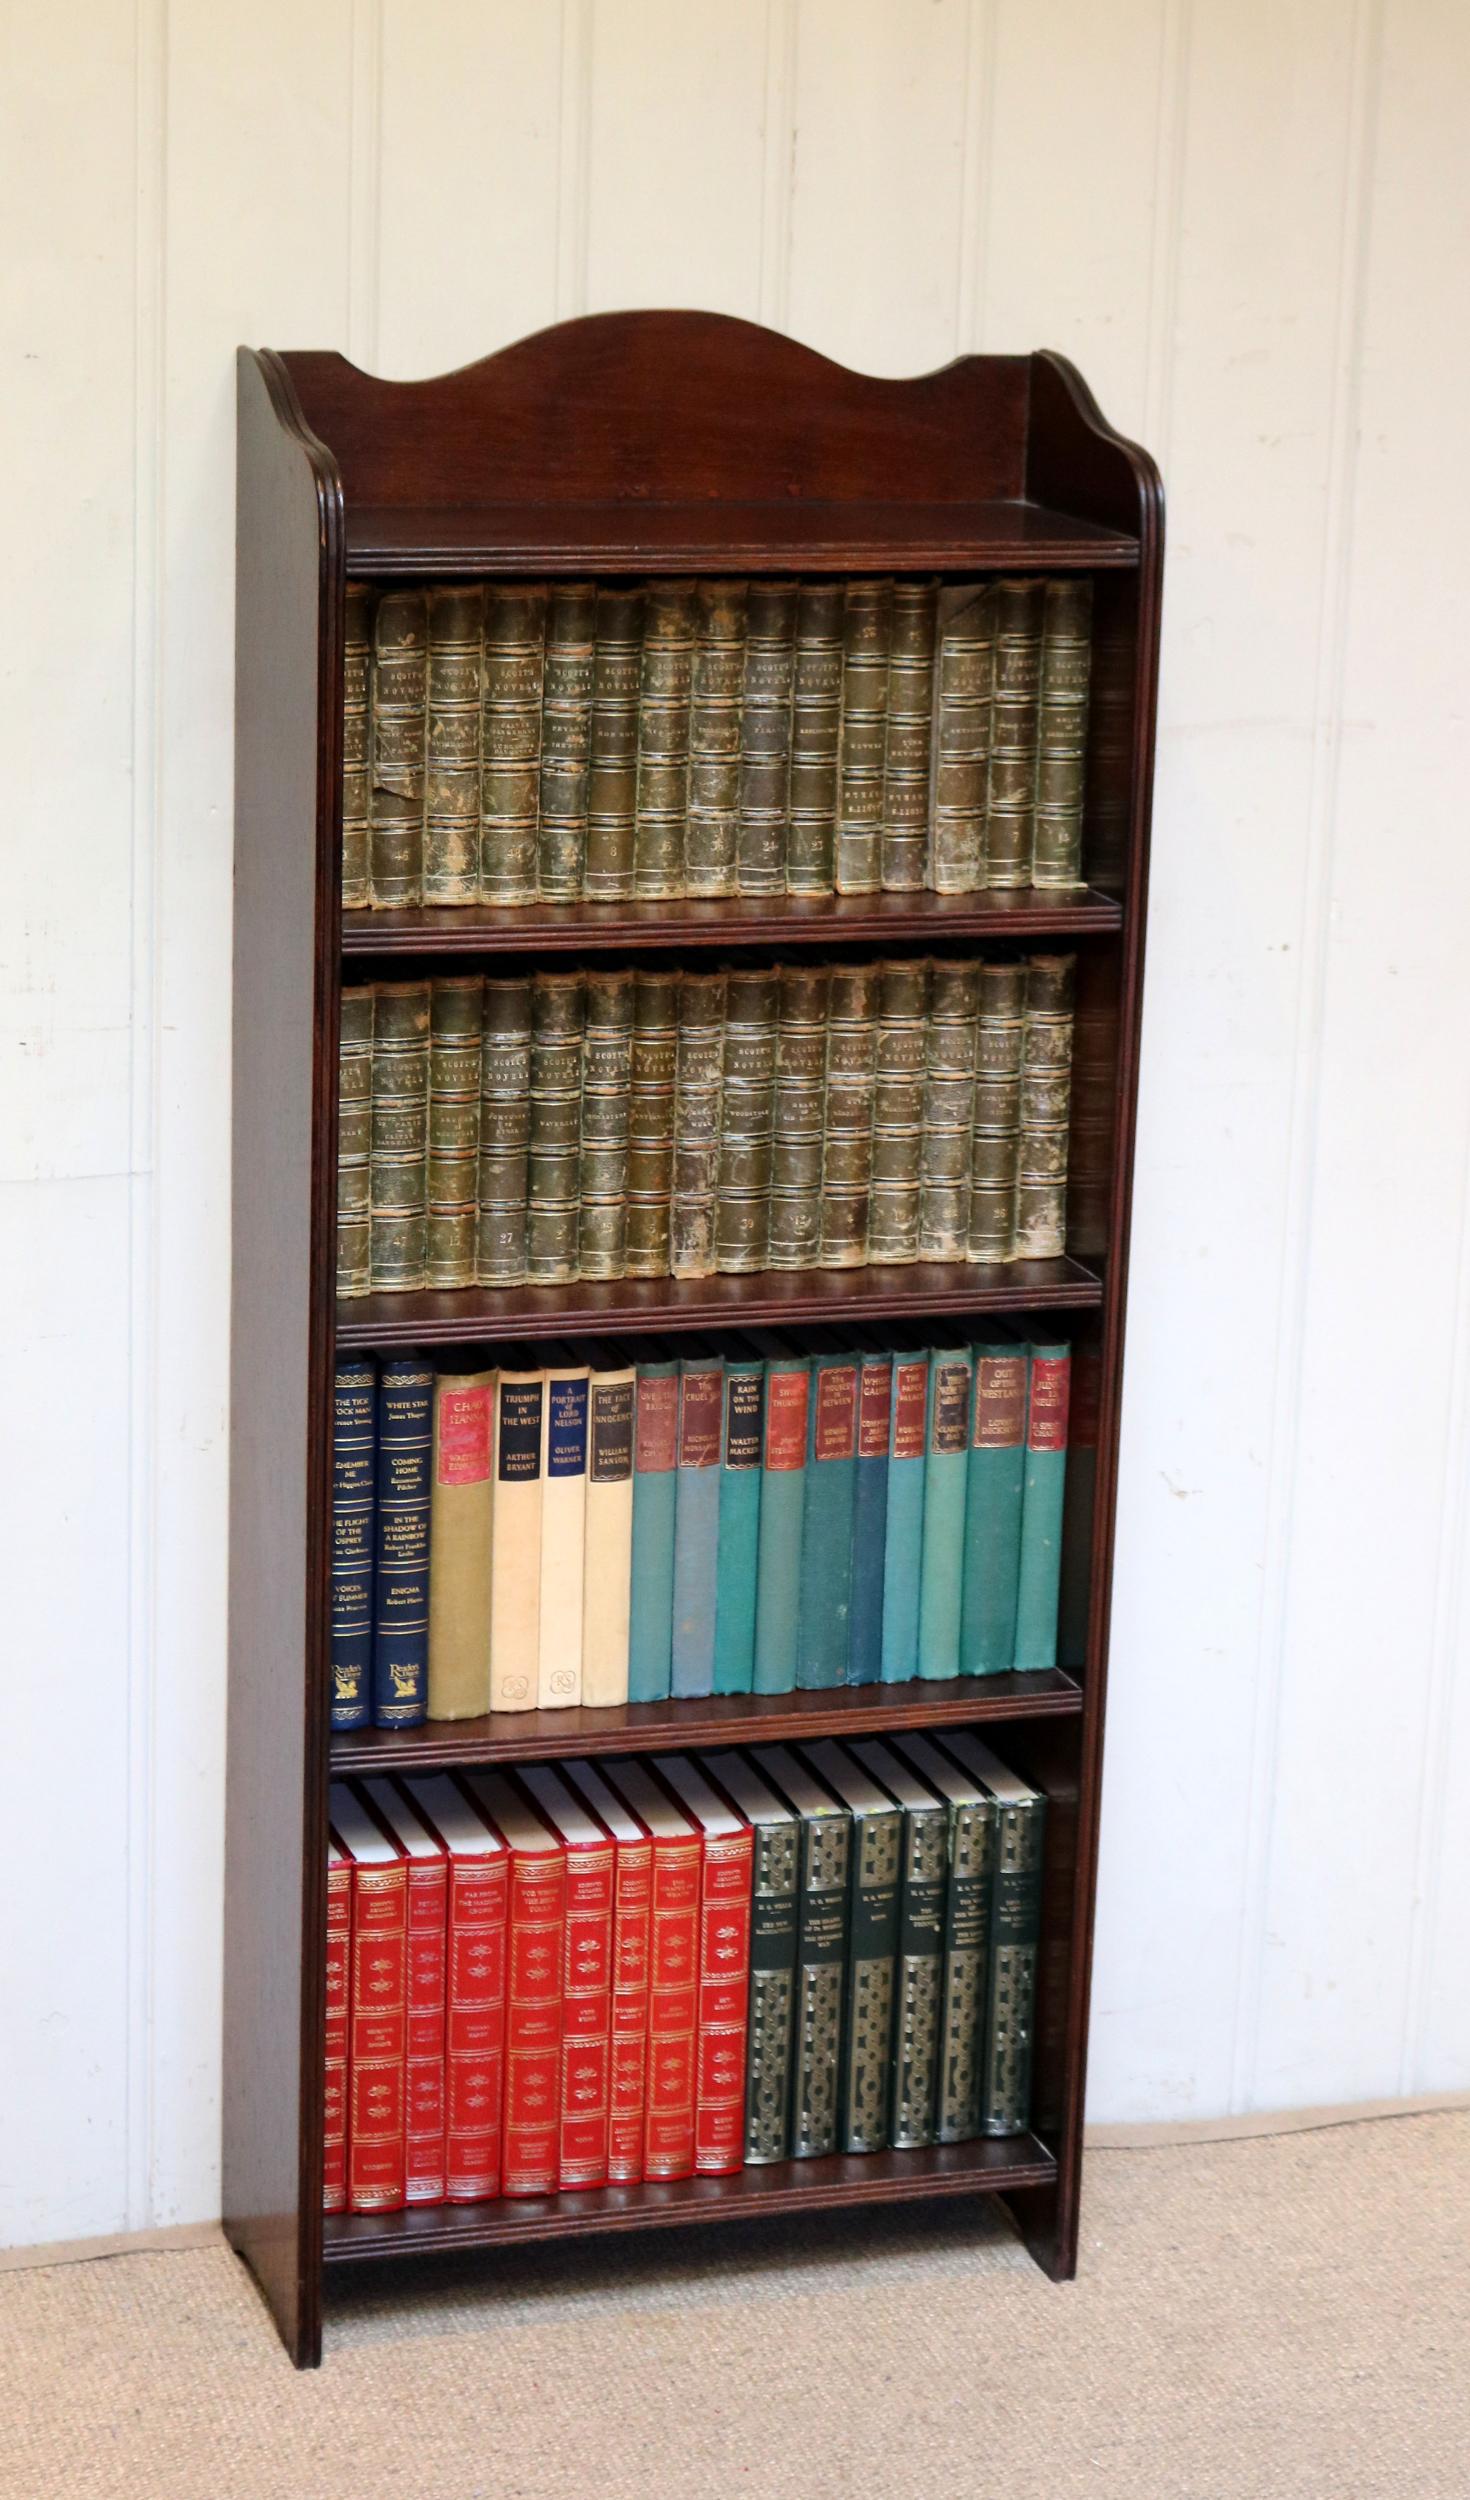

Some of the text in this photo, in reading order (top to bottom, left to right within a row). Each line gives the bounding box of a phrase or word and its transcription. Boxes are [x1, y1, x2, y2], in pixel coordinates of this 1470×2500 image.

[994, 1369, 1015, 1379] OUT
[737, 1384, 757, 1393] RAIN
[505, 1393, 540, 1403] TRIUMPH
[551, 1394, 586, 1404] PORTRAIT
[598, 1395, 613, 1404] THE
[734, 1404, 758, 1414] WIND
[503, 1415, 541, 1426] THE WEST
[554, 1418, 583, 1427] NELSON
[729, 1436, 760, 1446] WALTER
[554, 1445, 581, 1454] OLIVER
[598, 1446, 629, 1456] WILLIAM
[506, 1452, 536, 1461] ARTHUR
[335, 1460, 369, 1469] EMEMBER
[391, 1458, 423, 1466] COMING
[506, 1462, 536, 1471] BRYANT
[395, 1467, 418, 1475] HOME
[383, 1525, 417, 1533] SHADOW
[392, 1532, 426, 1541] RAINBOW
[391, 1587, 420, 1595] ENIGMA
